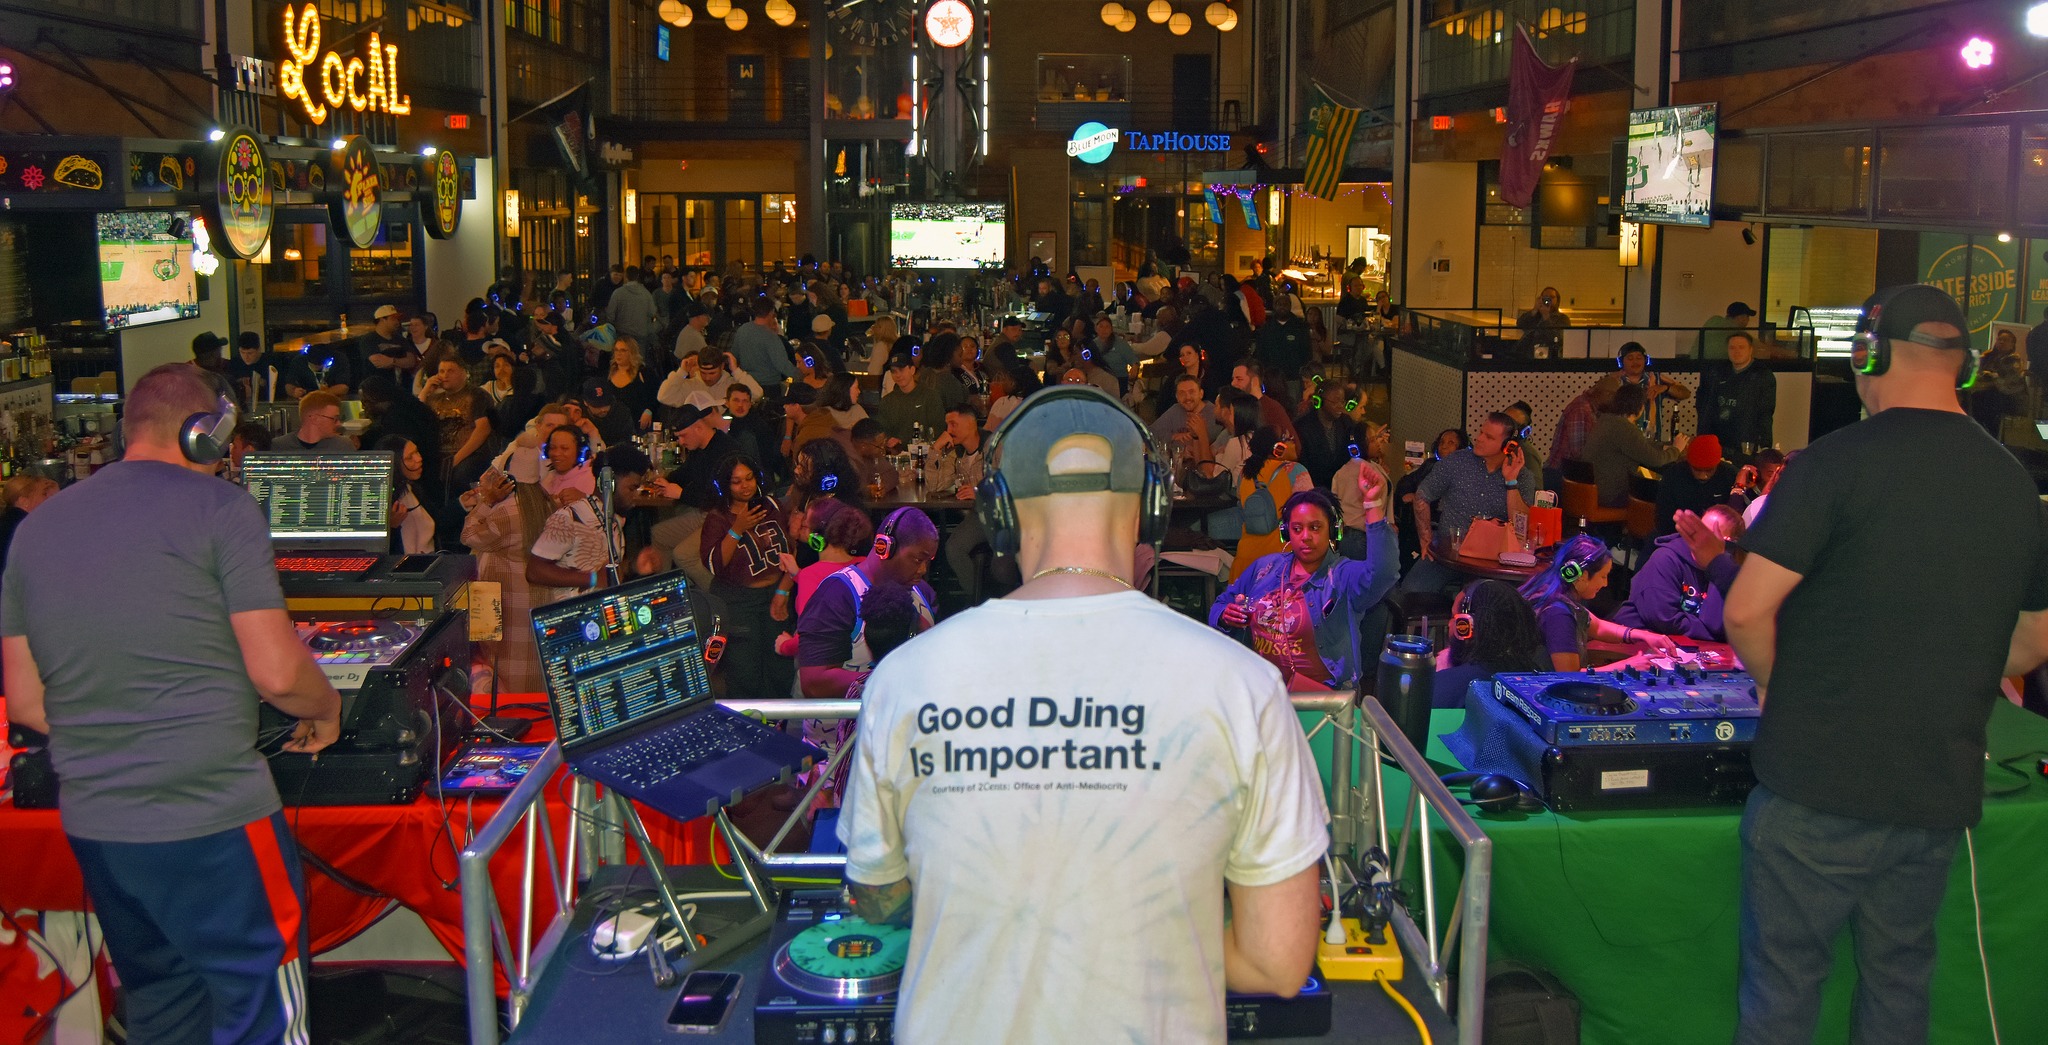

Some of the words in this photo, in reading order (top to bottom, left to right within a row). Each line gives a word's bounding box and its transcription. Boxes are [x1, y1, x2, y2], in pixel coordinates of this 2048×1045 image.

[231, 54, 277, 96] THE
[451, 115, 467, 129] EXIT
[1433, 116, 1451, 130] EXIT
[1068, 141, 1092, 155] BLUE
[1093, 131, 1118, 145] MOON
[737, 520, 789, 576] 13
[917, 697, 1015, 735] Good
[1028, 697, 1145, 736] DJing
[910, 747, 935, 778] Is
[944, 738, 1161, 778] Important.
[932, 785, 965, 794] Courtesy
[966, 783, 976, 792] of
[1013, 782, 1041, 791] Office
[1043, 782, 1054, 791] of
[1055, 782, 1128, 792] Anti-Mediocrity
